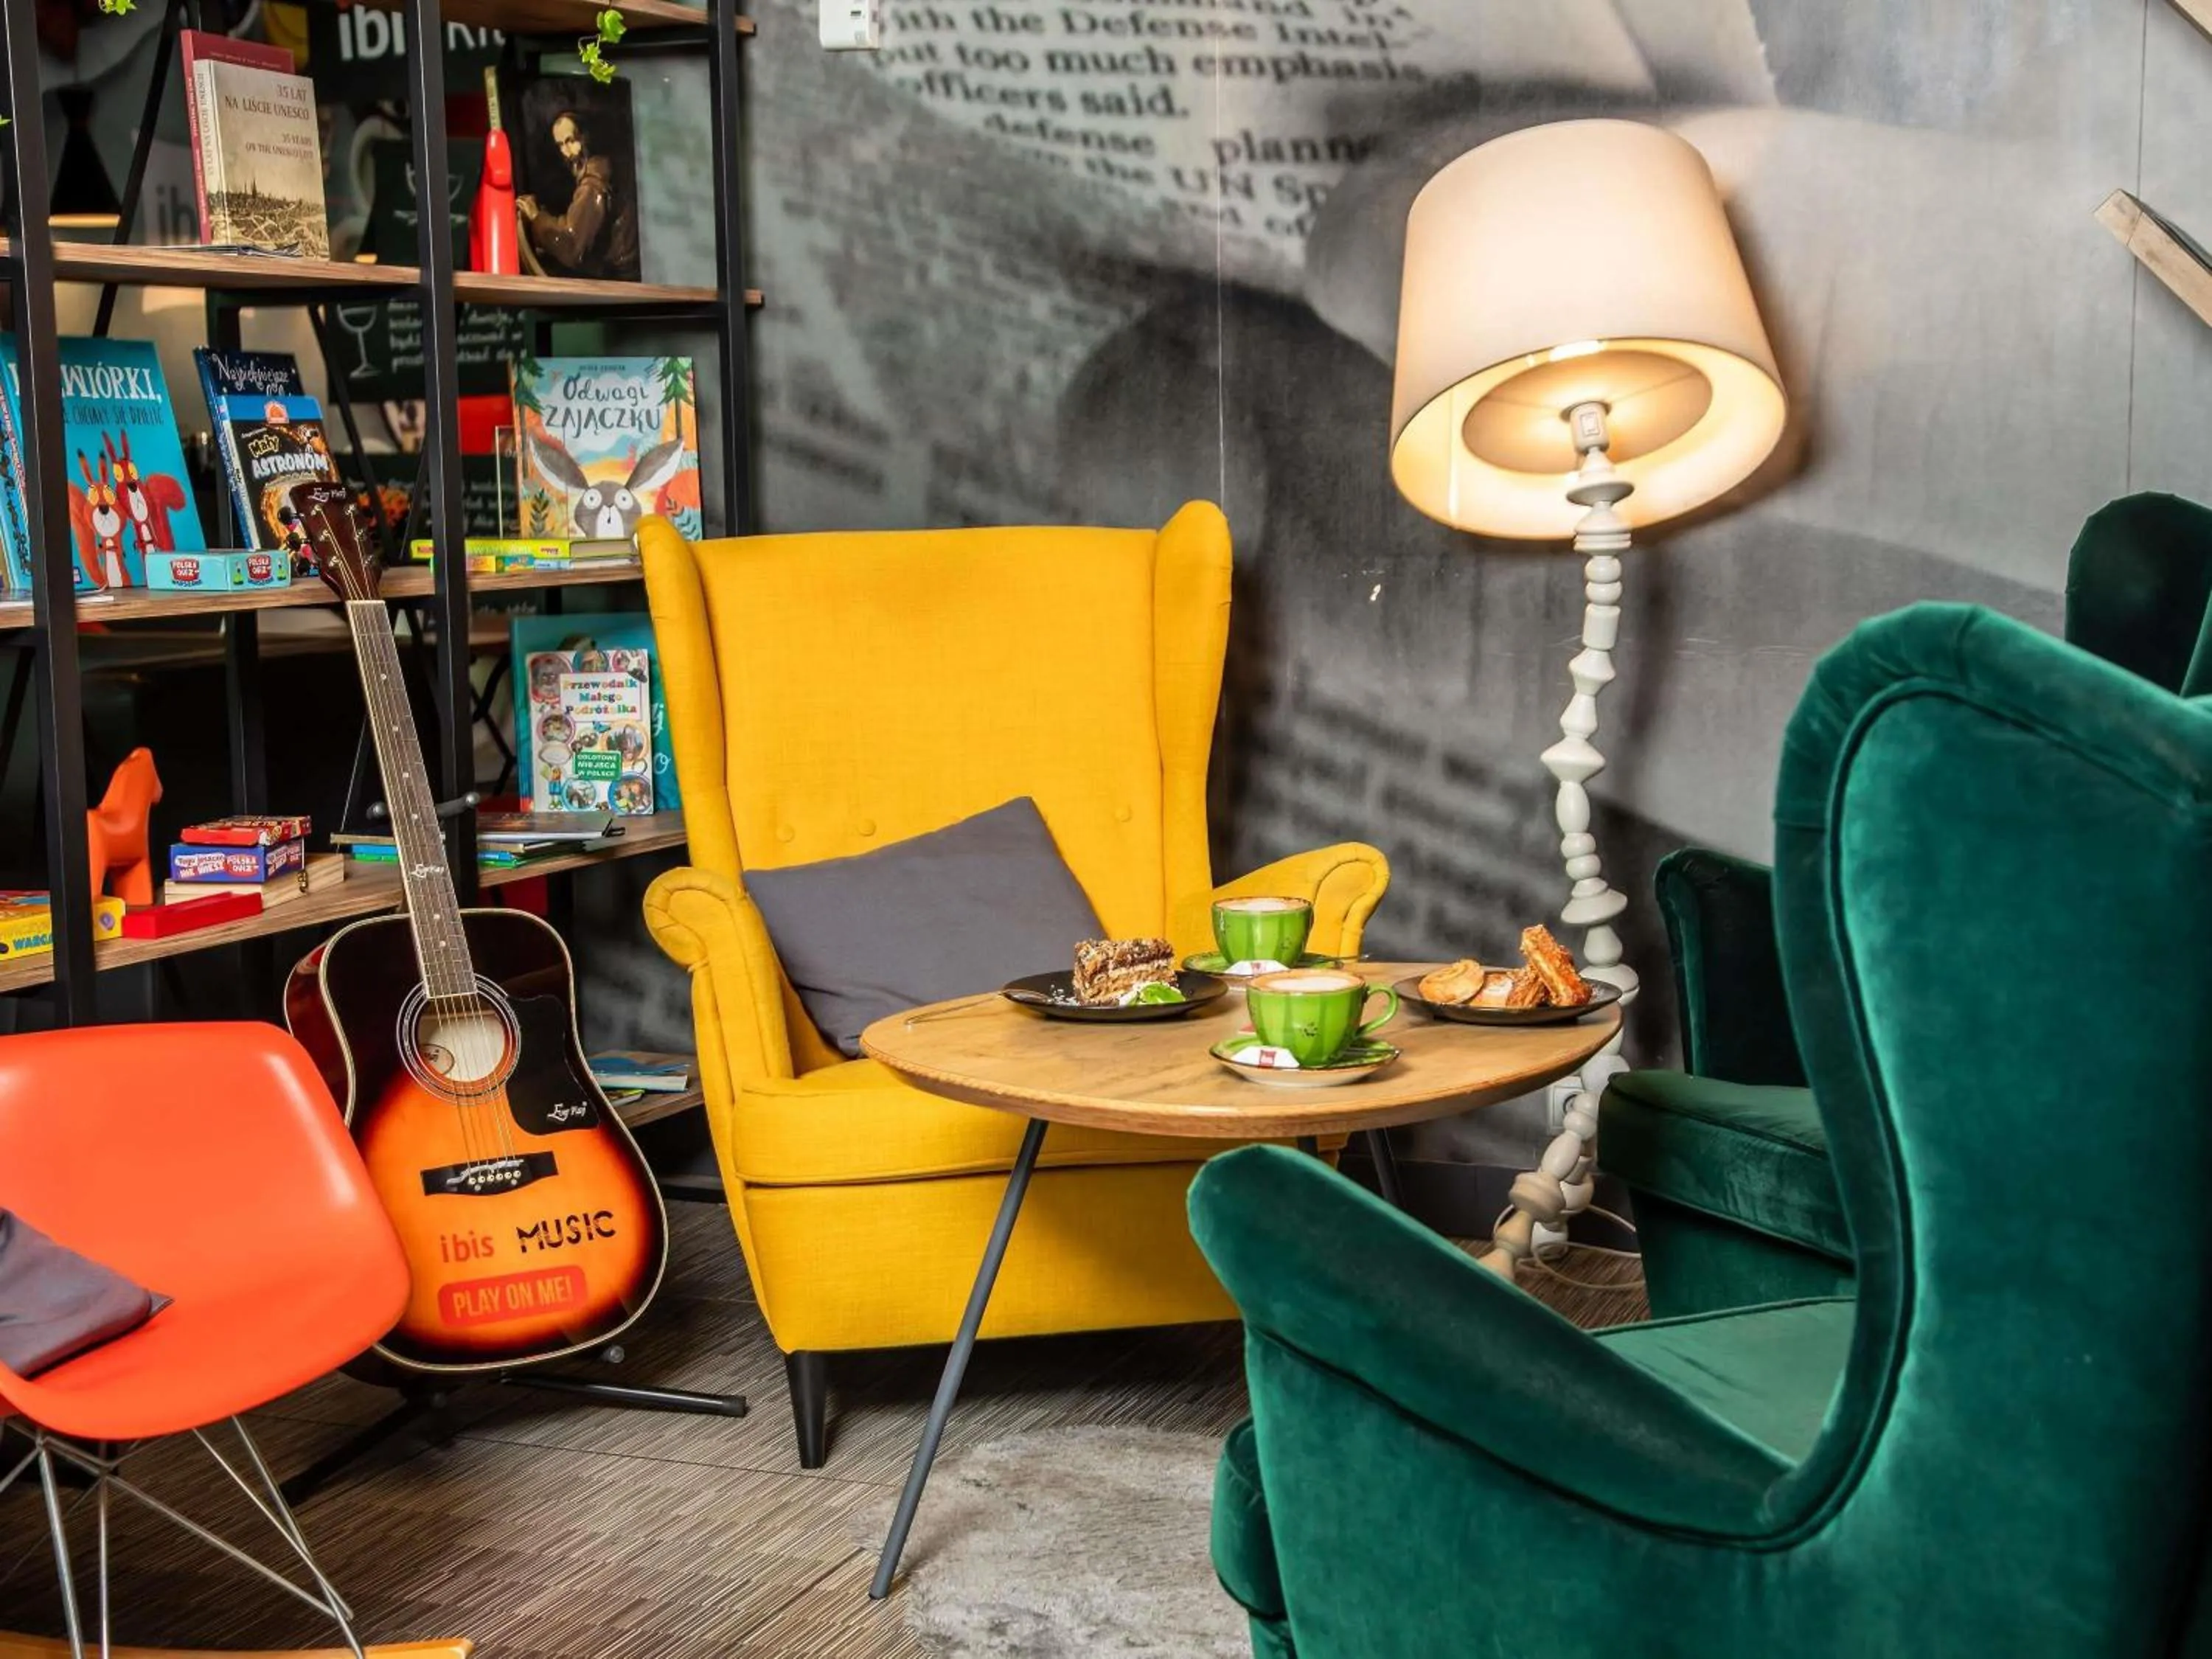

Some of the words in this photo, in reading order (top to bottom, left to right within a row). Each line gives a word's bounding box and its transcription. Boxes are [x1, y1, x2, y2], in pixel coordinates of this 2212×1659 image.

[971, 7, 1045, 34] the
[1060, 7, 1256, 41] Defense
[955, 42, 1030, 71] too
[1043, 44, 1175, 74] much
[1080, 81, 1189, 118] said.
[1169, 167, 1255, 201] UN
[563, 372, 650, 406] Odwagi
[545, 404, 661, 439] ZAJĄCZKU
[440, 1229, 495, 1263] ibis
[516, 1211, 616, 1253] MUSIC
[452, 1284, 501, 1319] PLAY
[506, 1279, 533, 1310] ON
[535, 1275, 574, 1306] ME!
